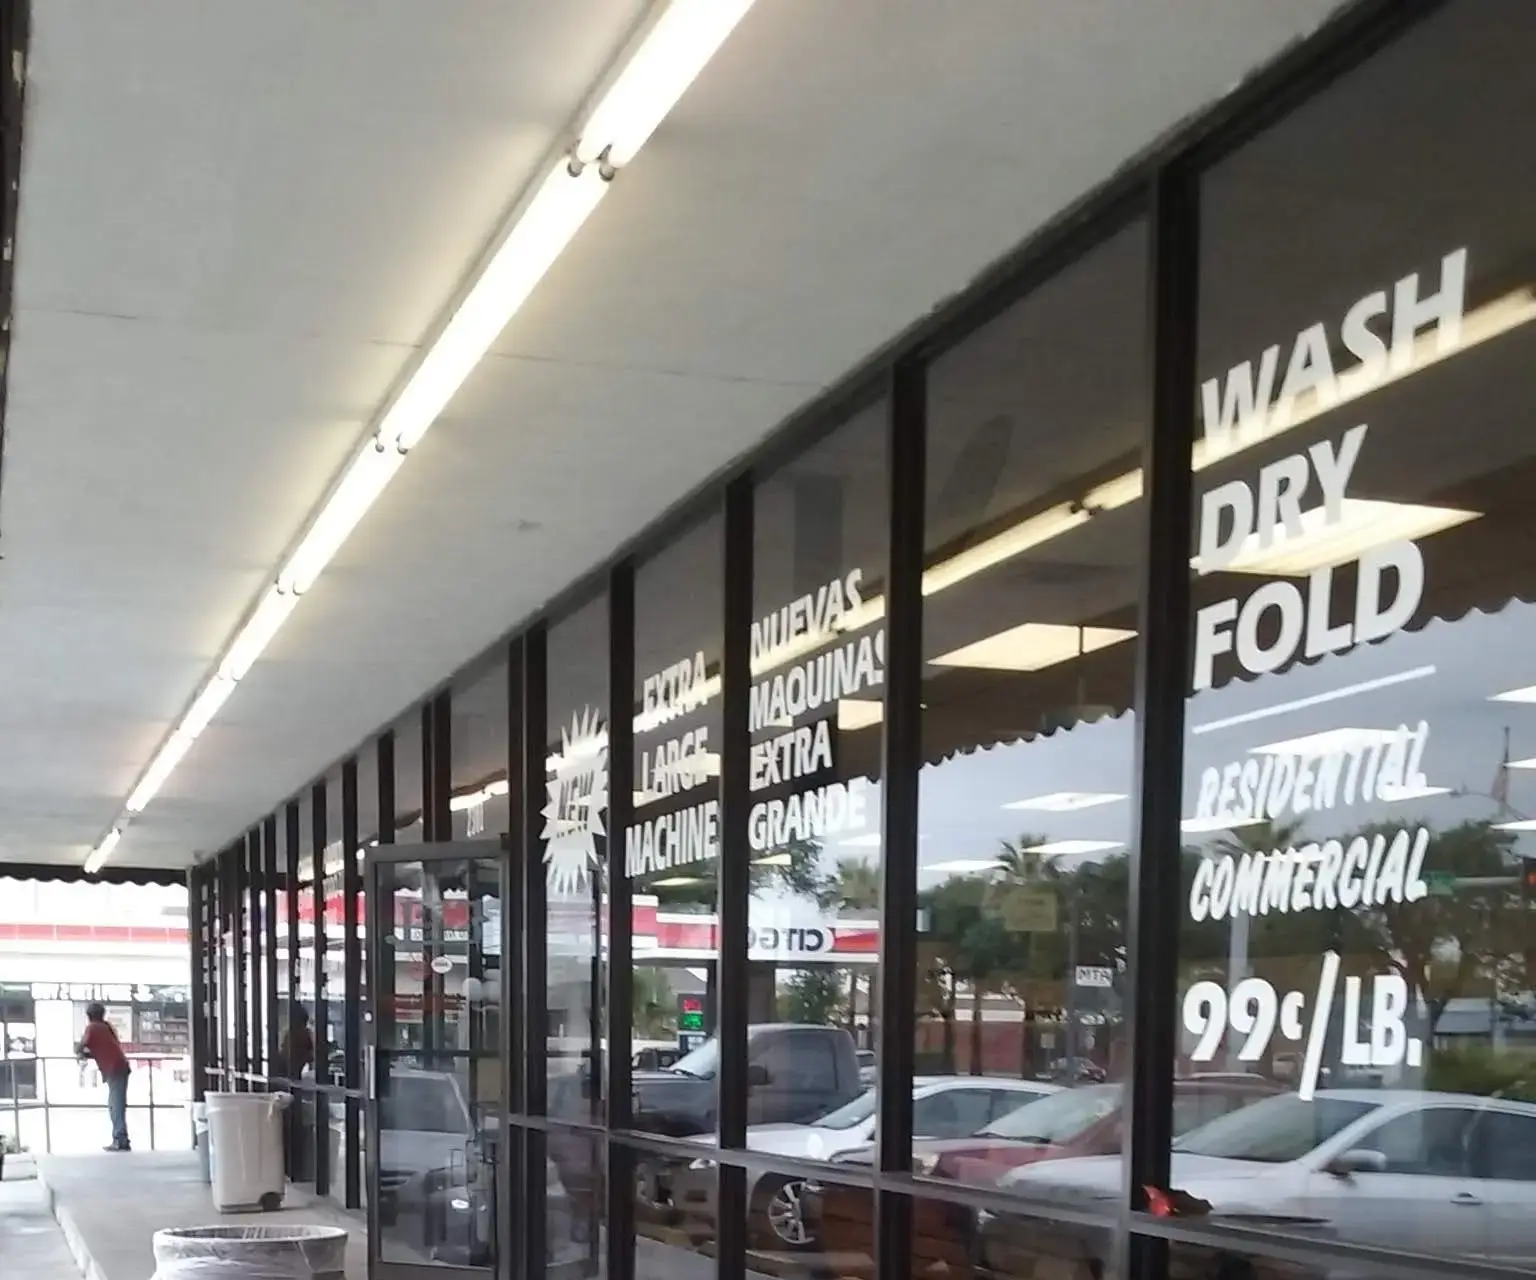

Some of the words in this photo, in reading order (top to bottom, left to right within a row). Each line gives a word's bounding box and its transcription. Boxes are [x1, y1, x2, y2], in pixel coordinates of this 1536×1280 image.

[1201, 248, 1467, 452] WASH
[1199, 424, 1368, 576] DRY
[750, 568, 863, 676] NUEVAS
[1193, 540, 1424, 690] FOLD
[643, 651, 708, 732] EXTRA
[748, 629, 885, 732] MAQUINAS
[642, 726, 708, 794] LARGE
[749, 720, 833, 792] EXTRA
[1195, 719, 1429, 821] RESIDENTIAL
[748, 776, 866, 850] GRANDE
[1189, 827, 1429, 922] COMMERCIAL
